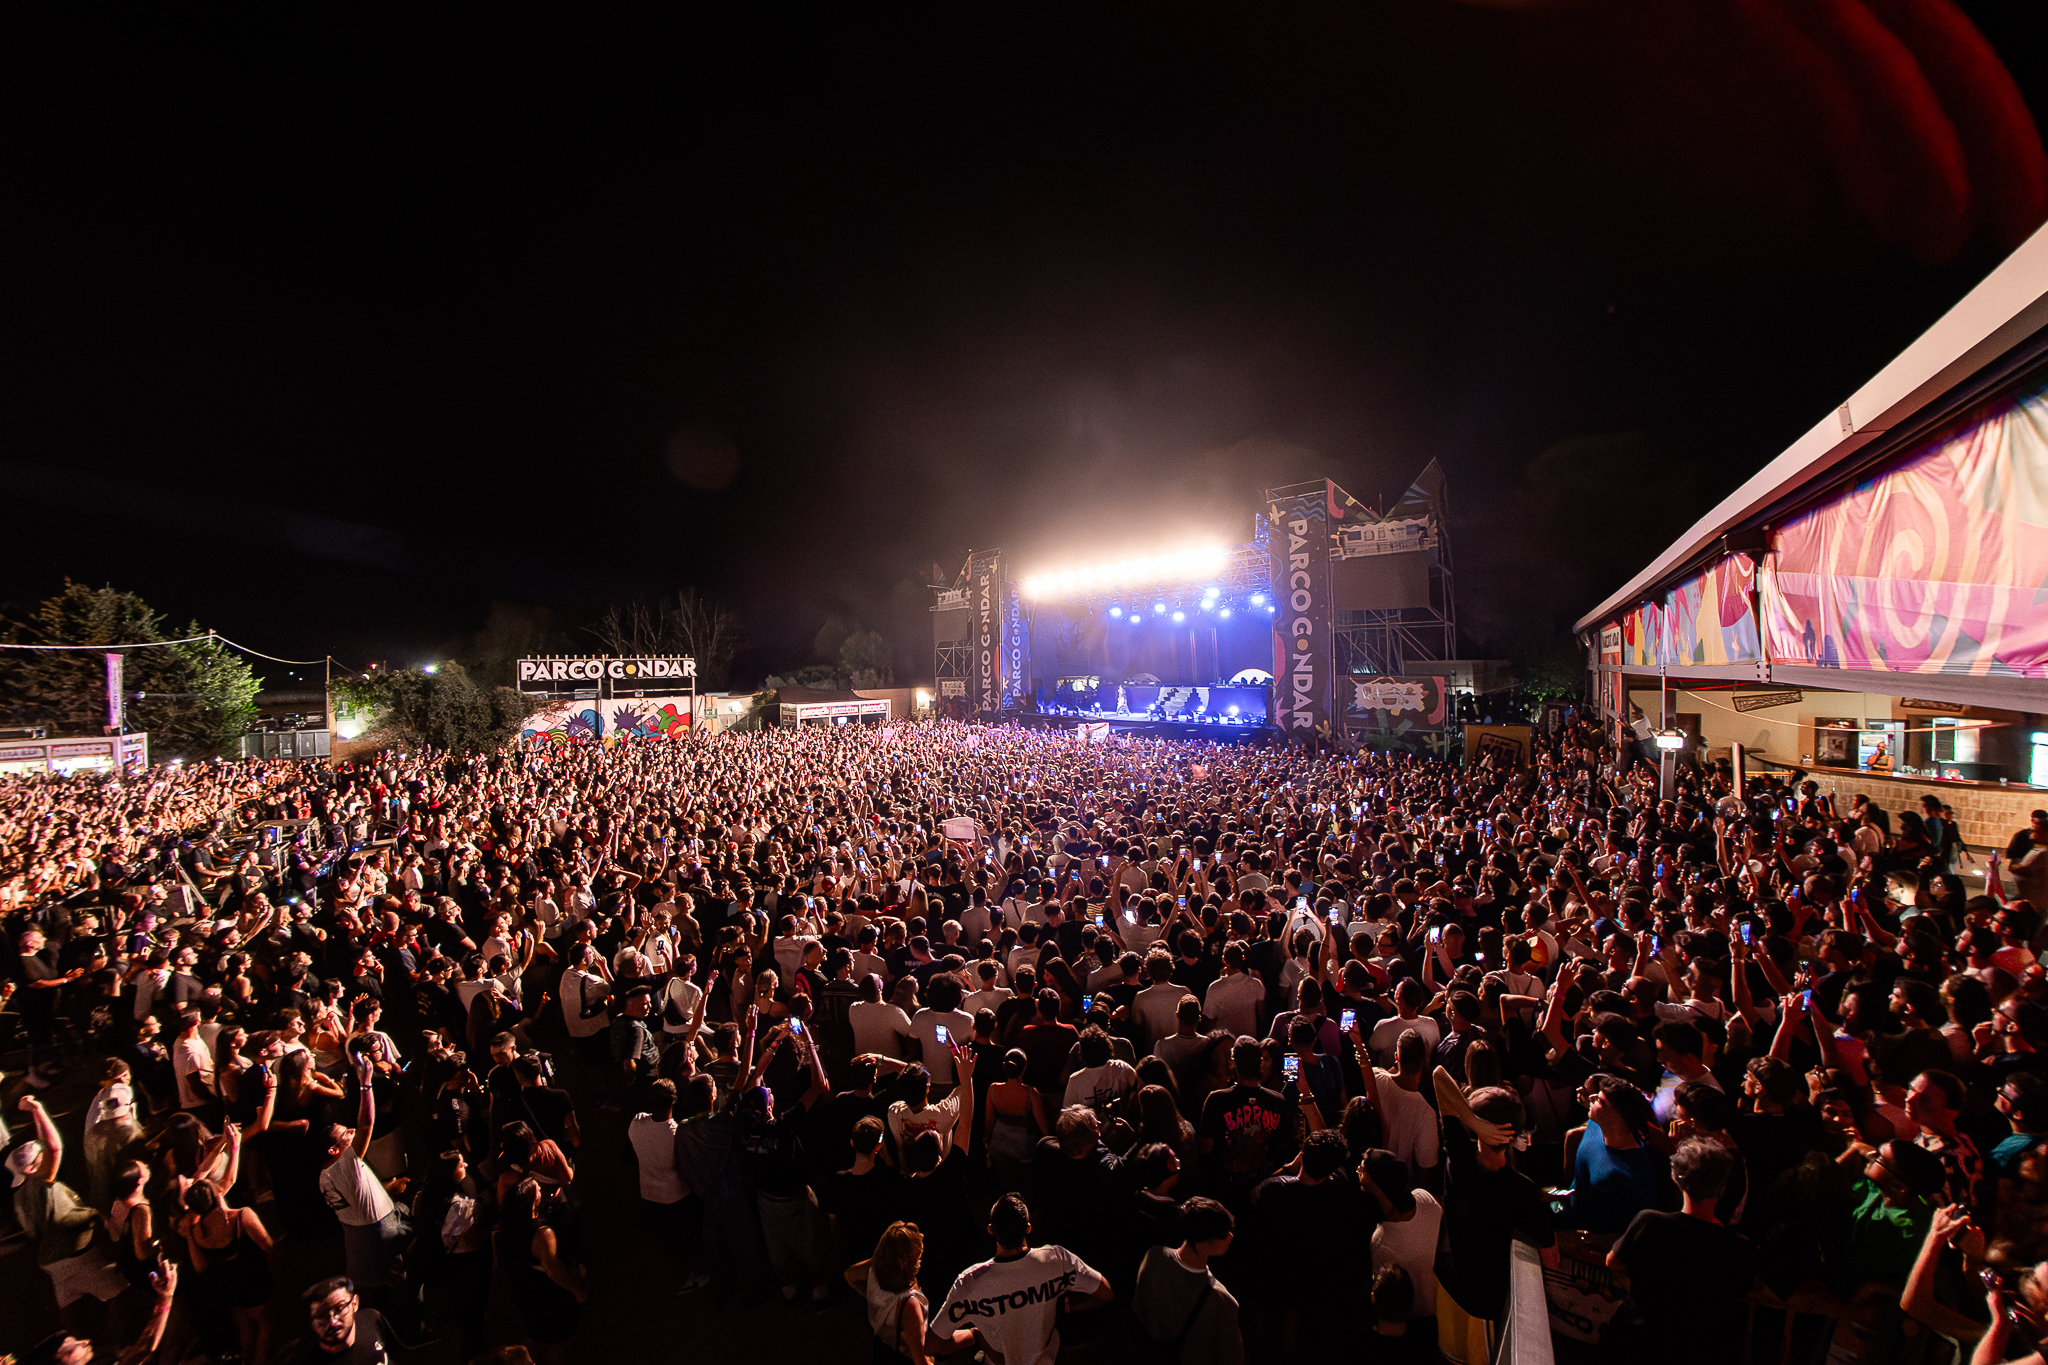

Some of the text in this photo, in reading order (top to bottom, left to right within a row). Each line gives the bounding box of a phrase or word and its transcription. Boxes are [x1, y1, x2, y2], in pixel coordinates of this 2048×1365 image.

[1288, 519, 1312, 611] PARCO
[520, 661, 605, 681] PARCO
[982, 650, 992, 712] PARCO
[1011, 648, 1022, 697] PARCO
